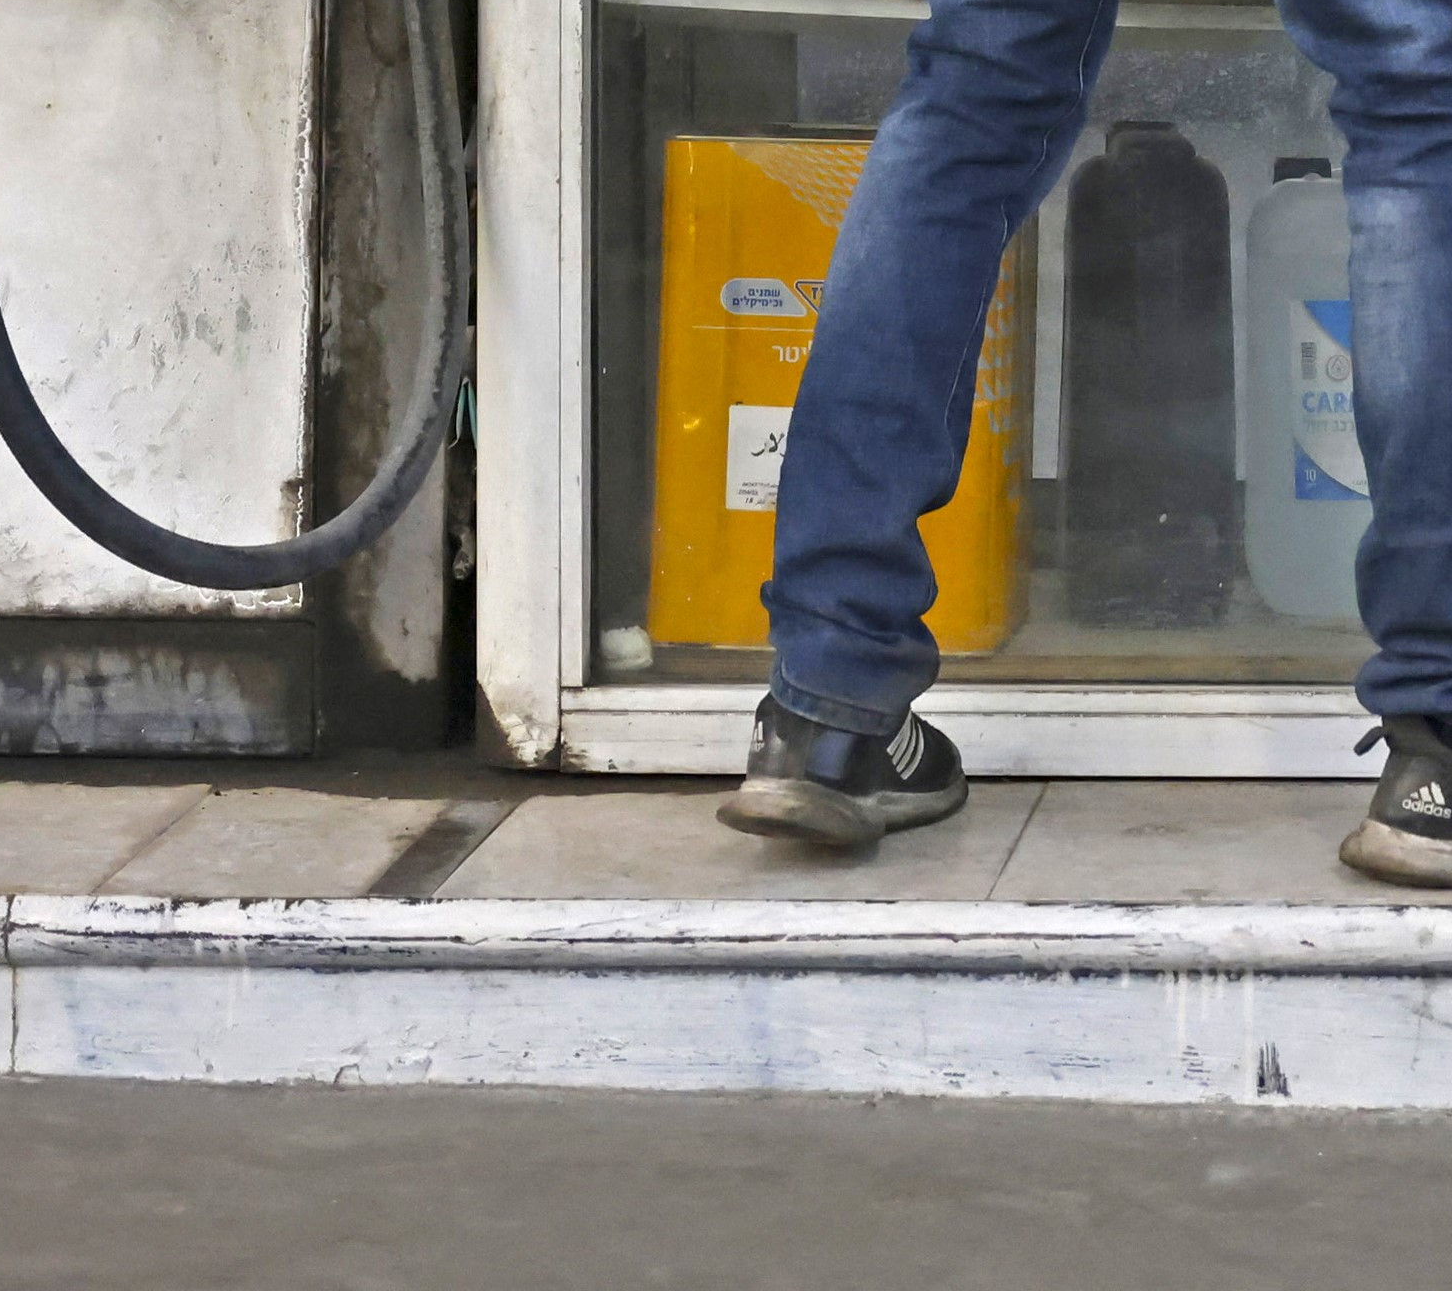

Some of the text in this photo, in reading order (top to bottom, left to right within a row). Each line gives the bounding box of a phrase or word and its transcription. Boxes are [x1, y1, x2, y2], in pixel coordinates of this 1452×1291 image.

[747, 288, 782, 297] שמנים
[731, 294, 784, 308] וכימיקלים
[1305, 469, 1317, 482] 10
[1401, 797, 1452, 819] adidas
